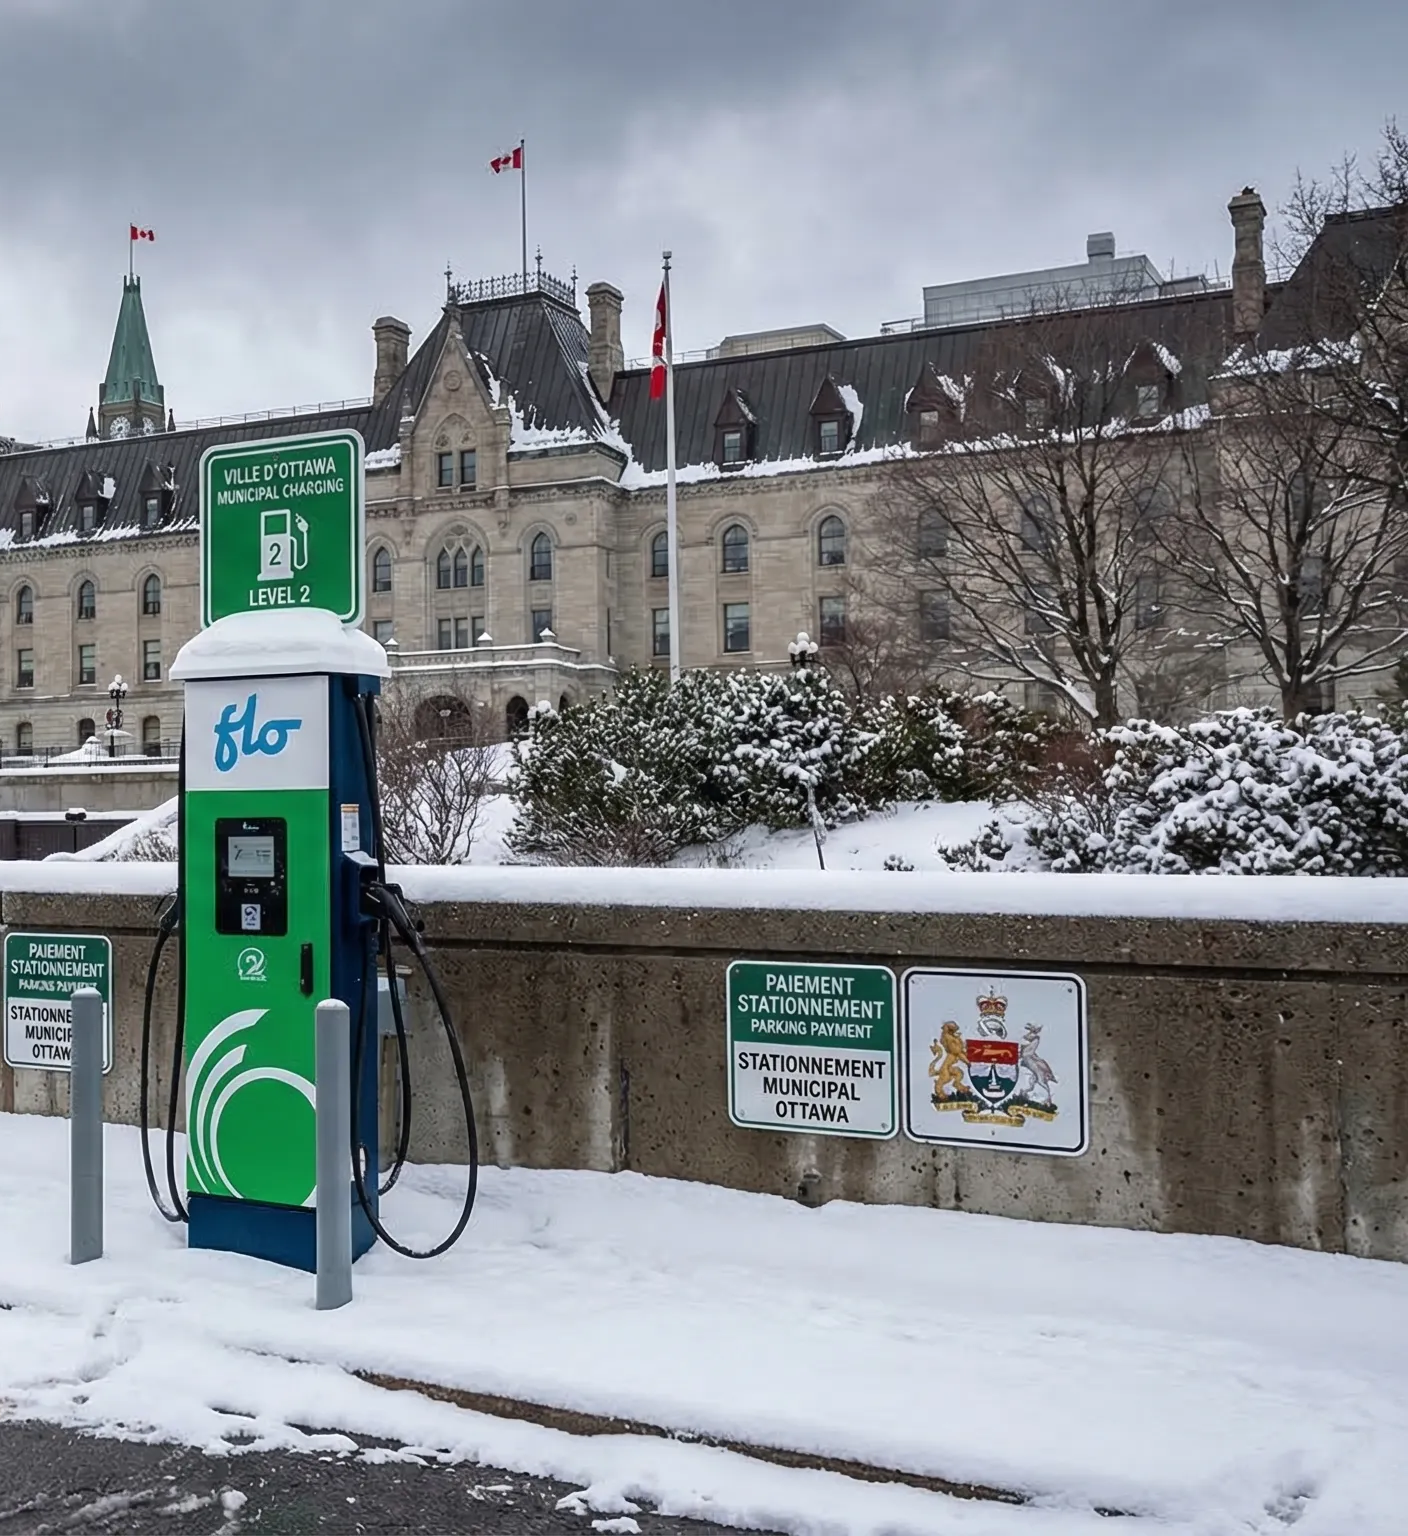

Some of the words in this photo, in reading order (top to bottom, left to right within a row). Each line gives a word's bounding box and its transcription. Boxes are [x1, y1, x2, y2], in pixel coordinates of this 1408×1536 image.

[224, 465, 260, 485] VILLE
[264, 456, 336, 481] D'OTTAWA
[217, 486, 280, 505] MUNICIPAL
[282, 477, 344, 498] CHARGING
[269, 542, 282, 566] 2
[249, 586, 295, 607] LEVEL
[300, 585, 311, 603] 2
[214, 693, 302, 772] flo
[29, 943, 86, 960] PAIEMENT
[11, 960, 105, 978] STATIONNEMENT
[766, 974, 855, 995] PAIEMENT
[11, 1005, 72, 1023] STATIONNE
[737, 994, 885, 1020] STATIONNEMENT
[25, 1025, 72, 1042] MUNICIP
[751, 1018, 807, 1035] PARKING
[810, 1021, 873, 1039] PAYMENT
[32, 1043, 72, 1061] OTTAW
[738, 1052, 886, 1079] STATIONNEMENT
[763, 1076, 861, 1101] MUNICIPAL
[775, 1100, 849, 1123] OTTAWA
